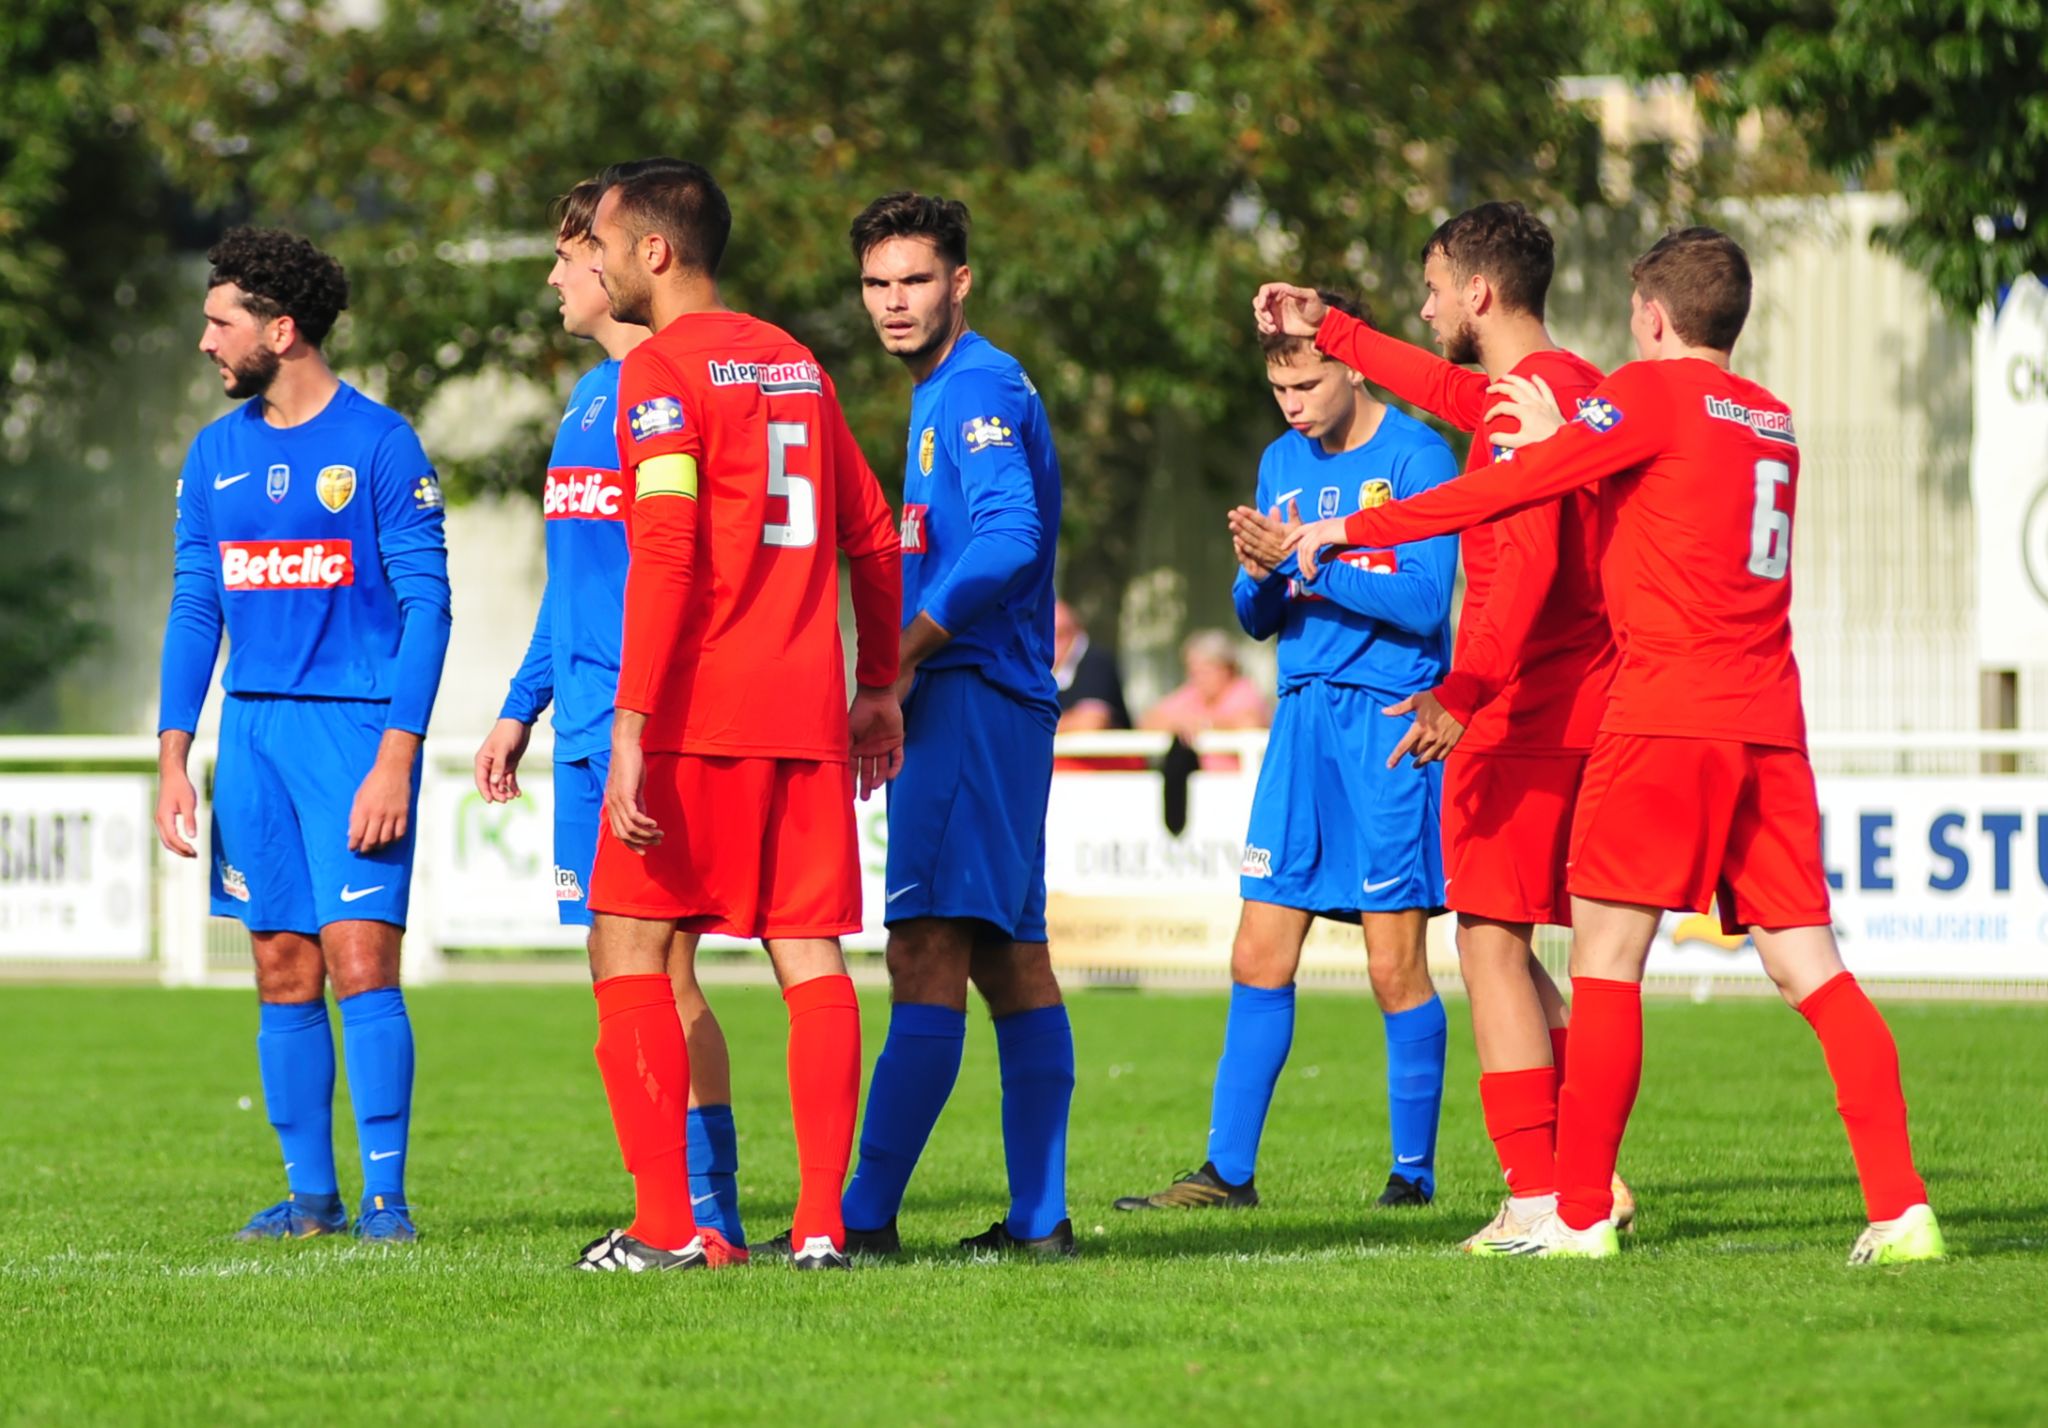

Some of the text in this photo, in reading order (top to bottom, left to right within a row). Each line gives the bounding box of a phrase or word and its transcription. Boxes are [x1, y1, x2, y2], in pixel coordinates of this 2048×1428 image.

[544, 472, 623, 515] Betclic
[761, 421, 817, 548] 5
[1747, 459, 1791, 581] 6
[221, 544, 347, 586] Betclic
[1928, 812, 2048, 892] ST
